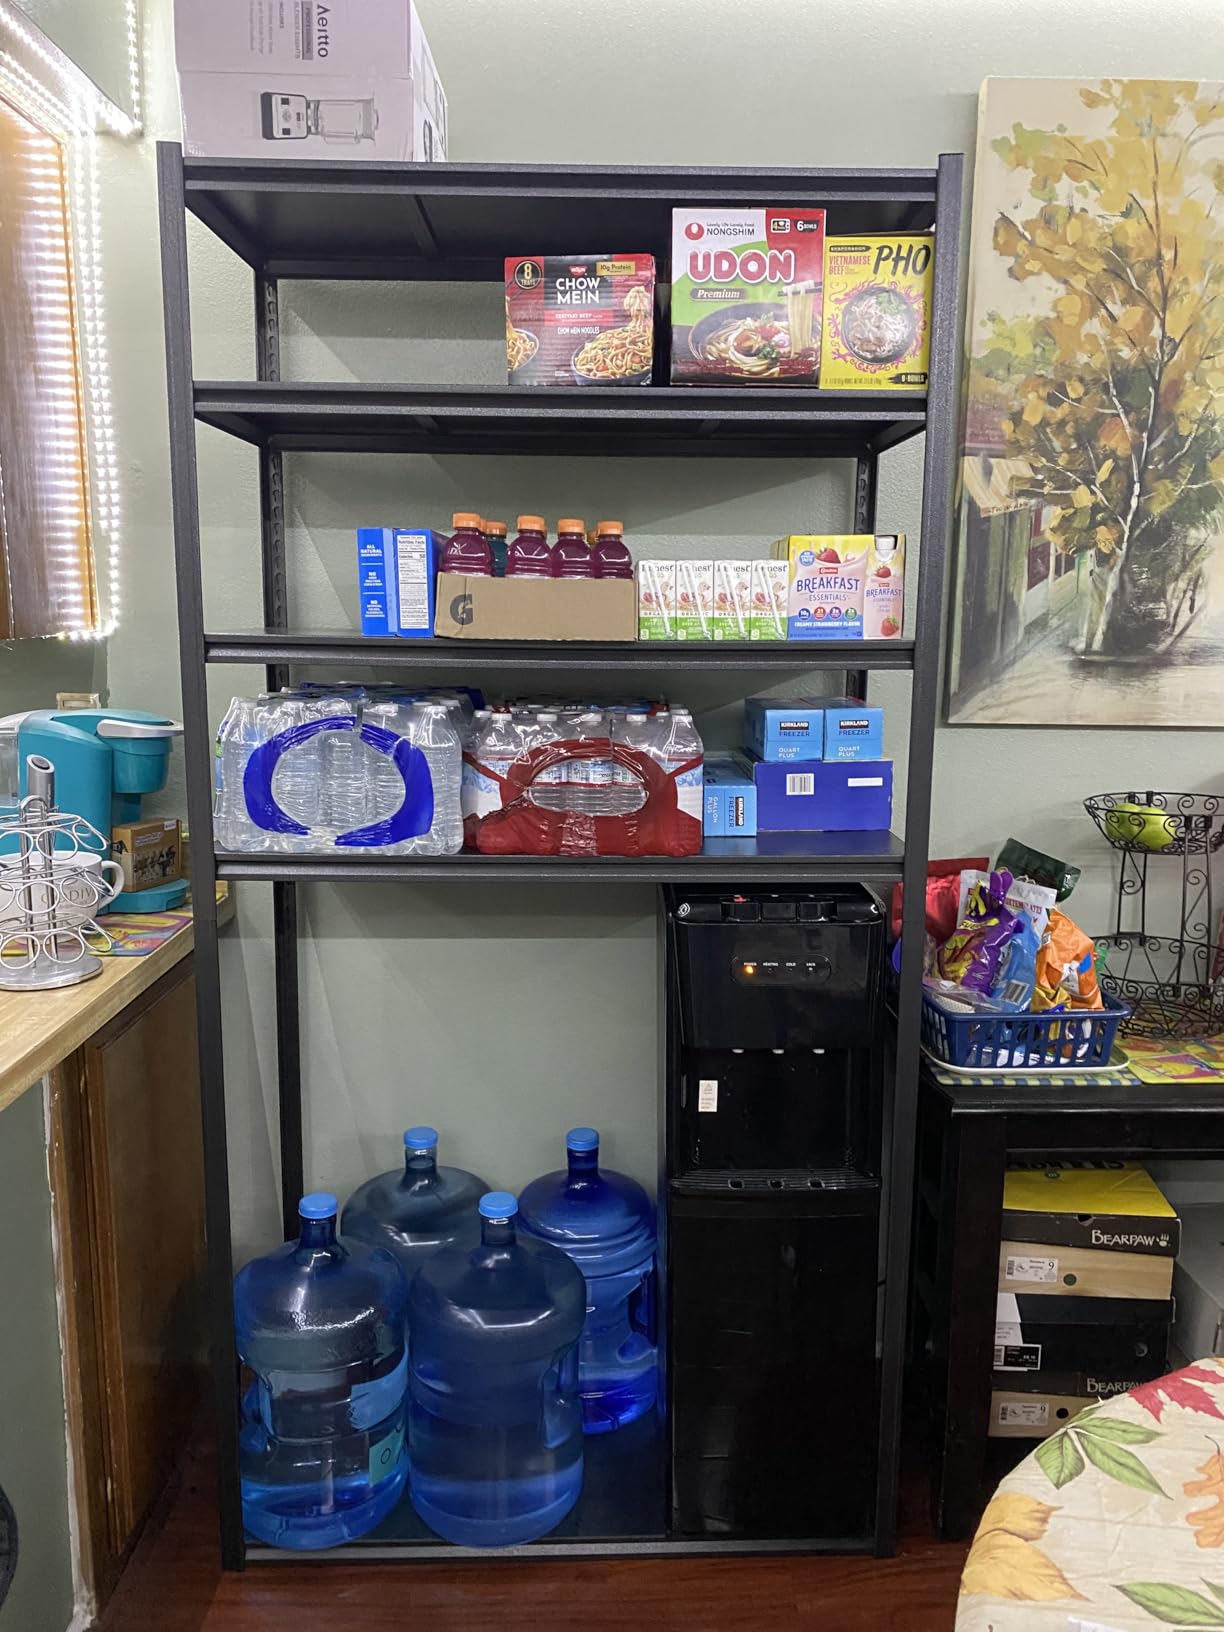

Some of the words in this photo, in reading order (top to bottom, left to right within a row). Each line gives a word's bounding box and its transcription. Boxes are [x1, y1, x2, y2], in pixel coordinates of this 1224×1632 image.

[797, 220, 804, 231] 6
[706, 228, 755, 236] NONGSHIM
[829, 256, 871, 265] VIETNAMESE
[873, 243, 931, 277] PHO
[524, 263, 533, 280] 8
[611, 263, 632, 271] Protein
[688, 250, 795, 283] UDON
[829, 265, 845, 275] BEEF
[555, 277, 600, 290] CHOW
[557, 290, 600, 305] MEIN
[697, 289, 740, 299] Premium
[581, 326, 600, 334] NOODLES
[641, 564, 674, 572] nest
[679, 564, 713, 572] nest
[754, 564, 788, 572] nest
[796, 577, 860, 593] BREAKFAST
[808, 594, 847, 602] ESSENTIALS
[866, 589, 902, 598] BREAKFAST
[1091, 1229, 1154, 1246] BEARPAW
[1048, 1261, 1055, 1271] 9
